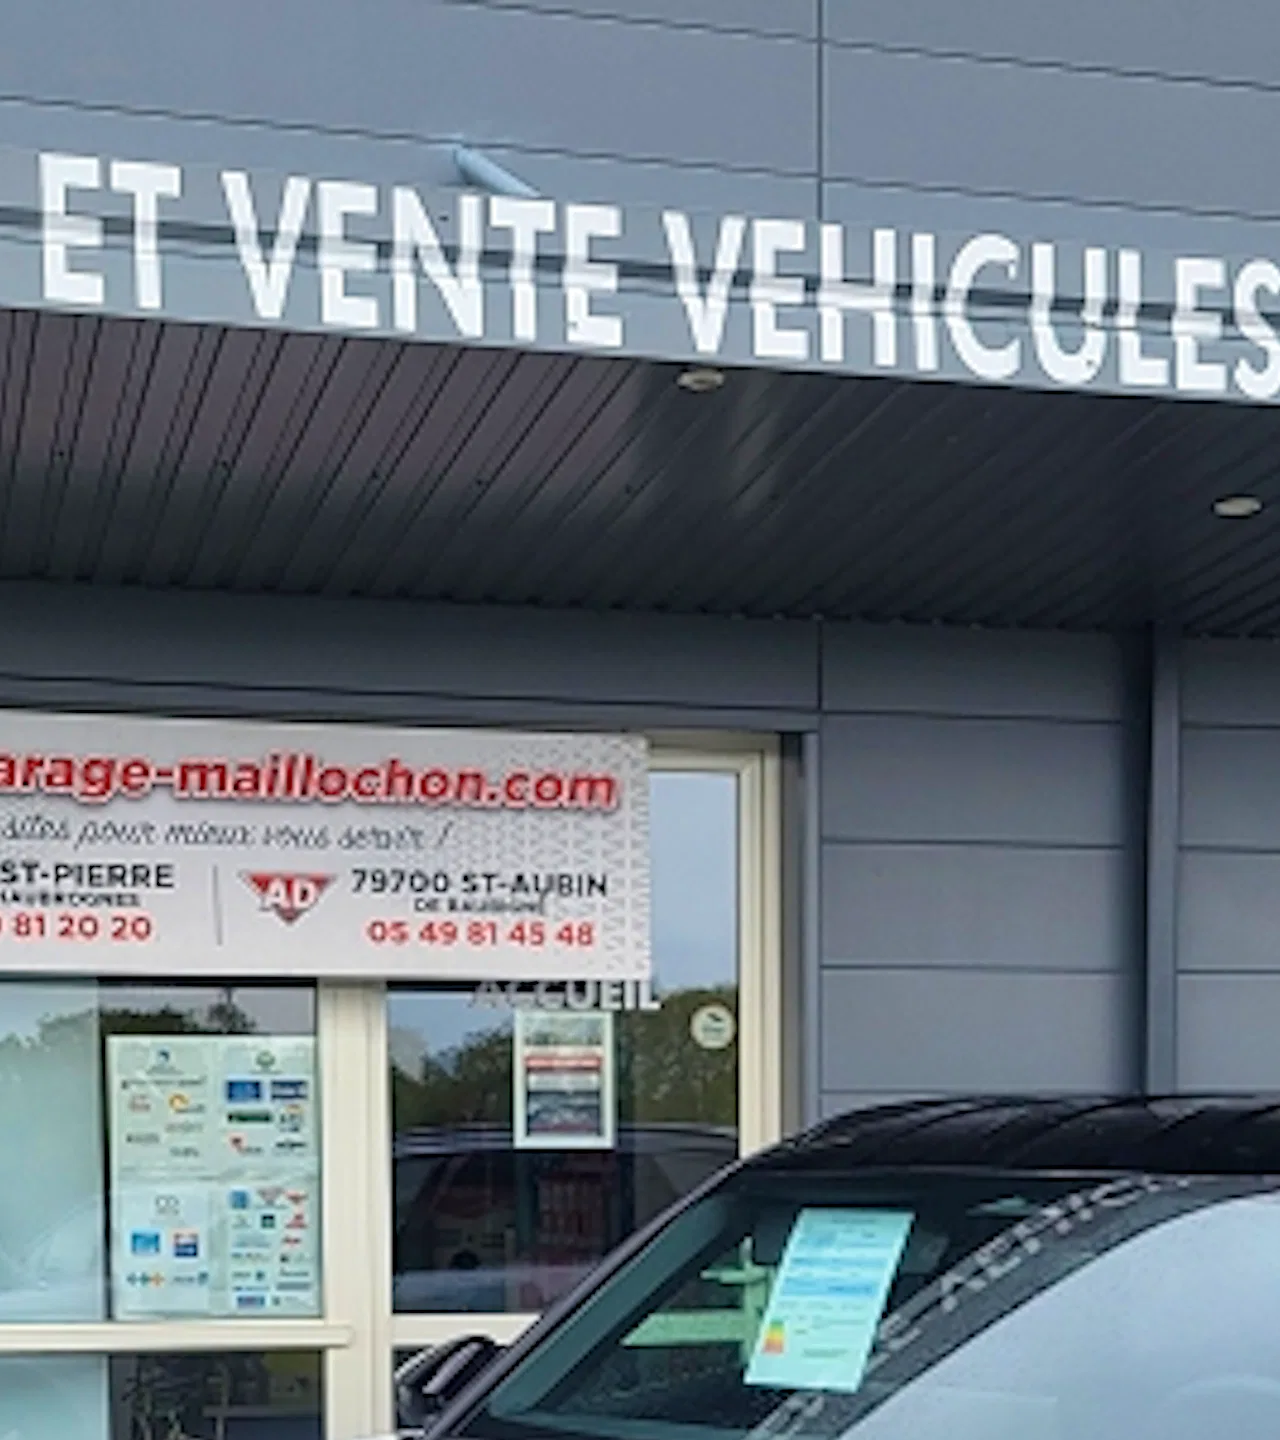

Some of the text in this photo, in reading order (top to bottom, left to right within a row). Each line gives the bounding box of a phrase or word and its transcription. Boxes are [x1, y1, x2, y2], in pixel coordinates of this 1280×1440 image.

[38, 151, 181, 311] ET
[221, 169, 625, 348] VENTE
[0, 860, 175, 889] ST-PIERRE
[351, 868, 608, 898] 79700 ST-AUBIN
[260, 877, 320, 910] AD
[13, 912, 46, 937] 81
[58, 913, 99, 939] 20
[110, 914, 152, 940] 20
[368, 920, 594, 946] 05 49 81 45 48
[470, 979, 662, 1012] ACCUEIL
